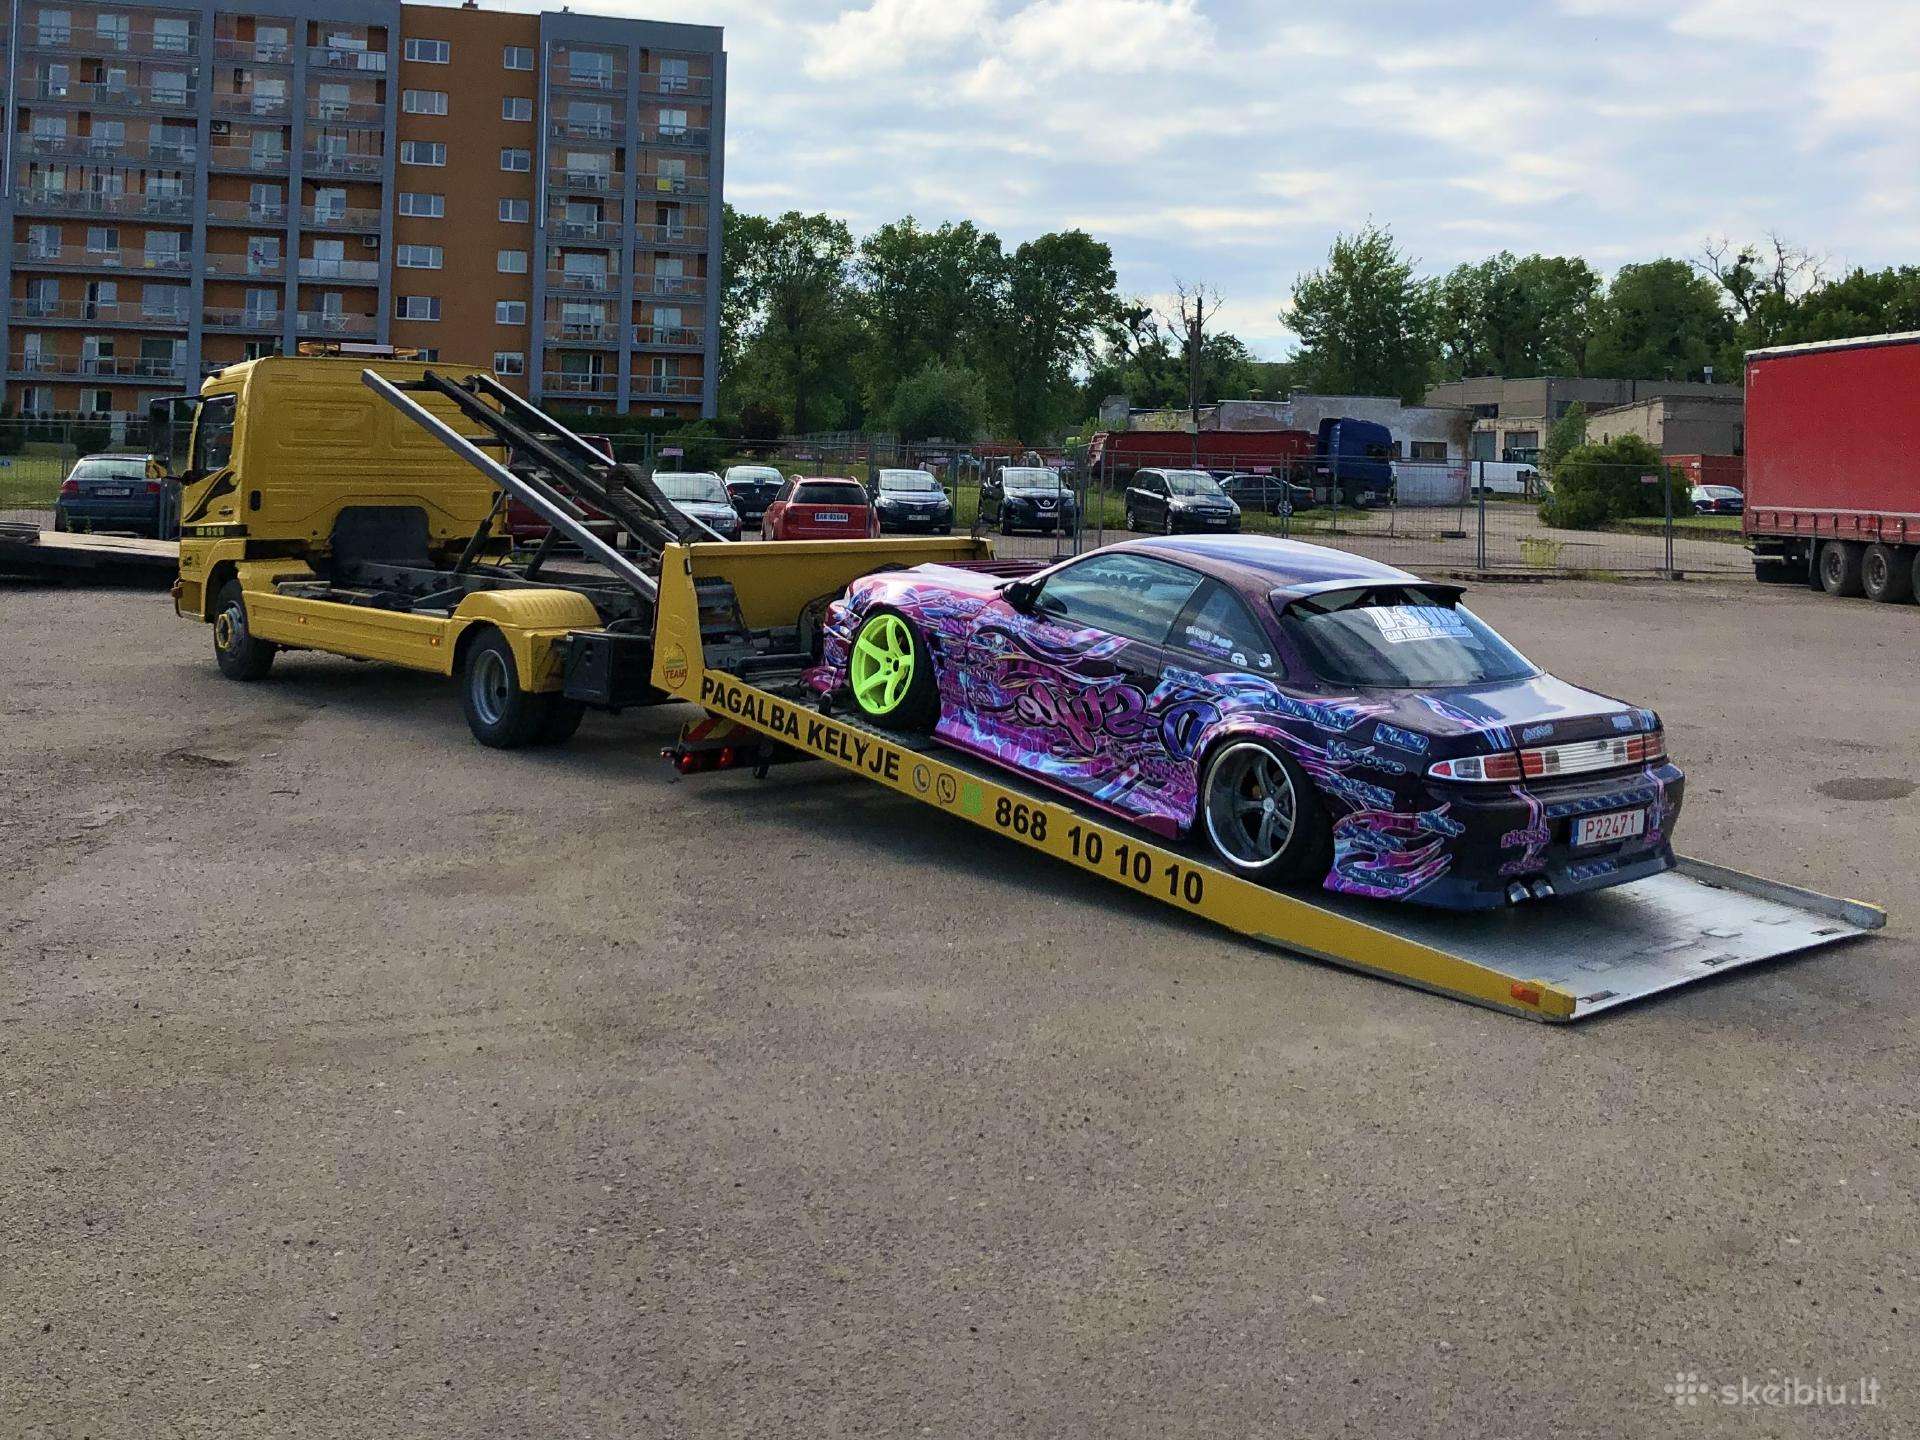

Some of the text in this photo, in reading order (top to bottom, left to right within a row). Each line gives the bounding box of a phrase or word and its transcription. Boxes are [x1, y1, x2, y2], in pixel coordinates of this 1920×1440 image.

[701, 676, 901, 781] PAGALBA KELYJE
[995, 796, 1204, 904] 868 10 10 10
[1585, 814, 1636, 841] P22471
